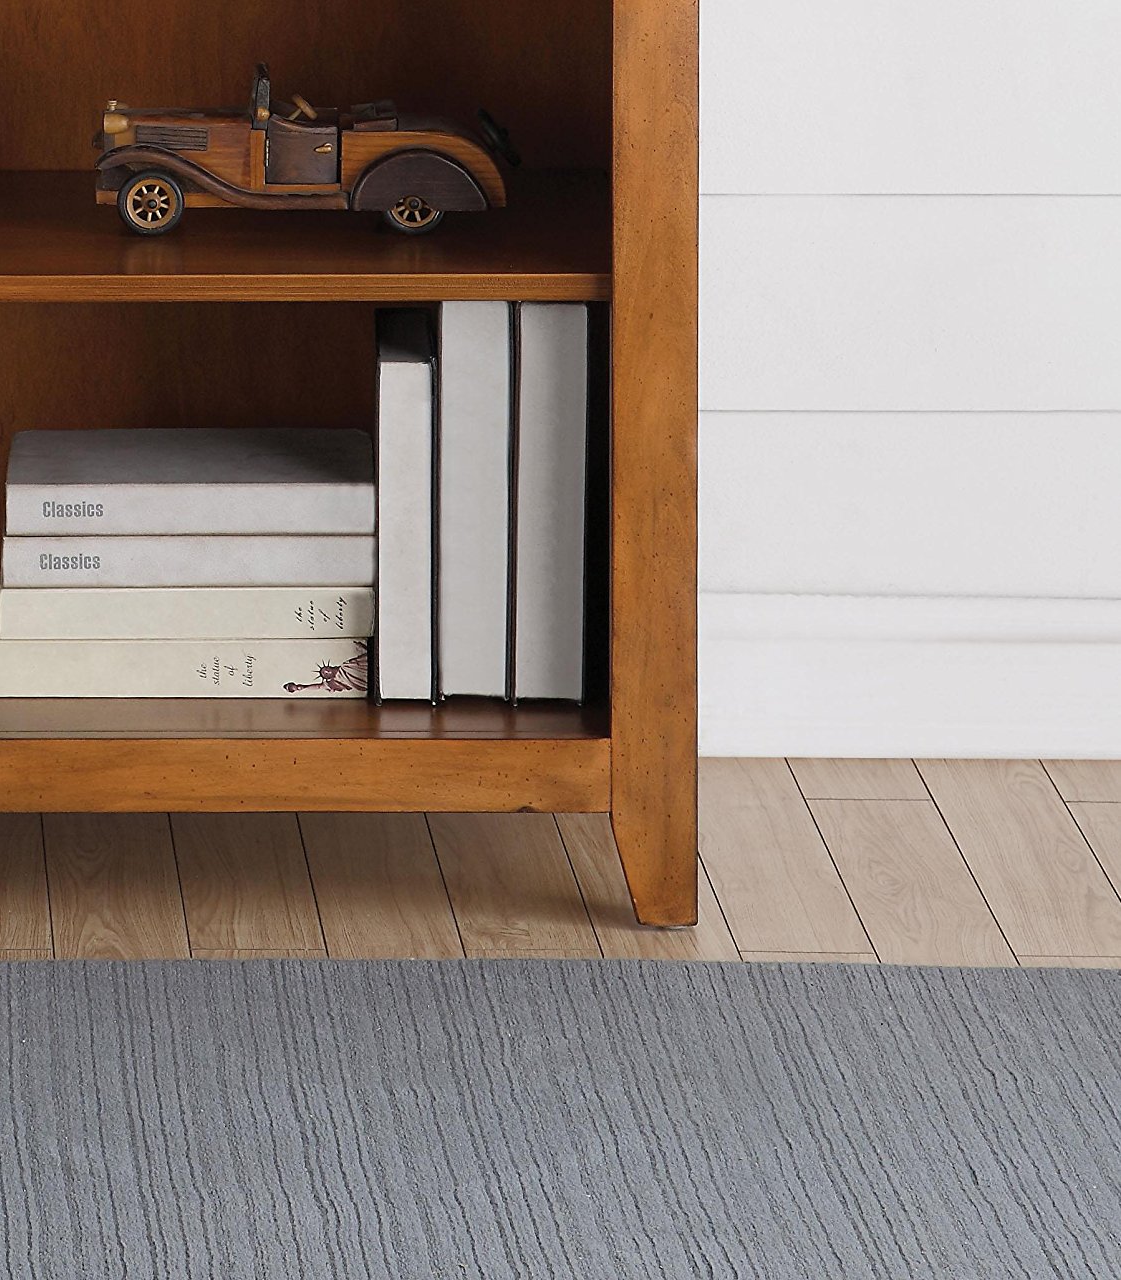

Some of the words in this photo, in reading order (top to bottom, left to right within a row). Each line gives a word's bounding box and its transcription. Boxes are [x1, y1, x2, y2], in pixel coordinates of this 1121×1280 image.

[42, 501, 104, 518] Classics
[39, 553, 101, 570] Classics
[196, 663, 207, 679] the
[211, 656, 221, 686] statue
[223, 663, 238, 677] of
[242, 653, 256, 687] liberty
